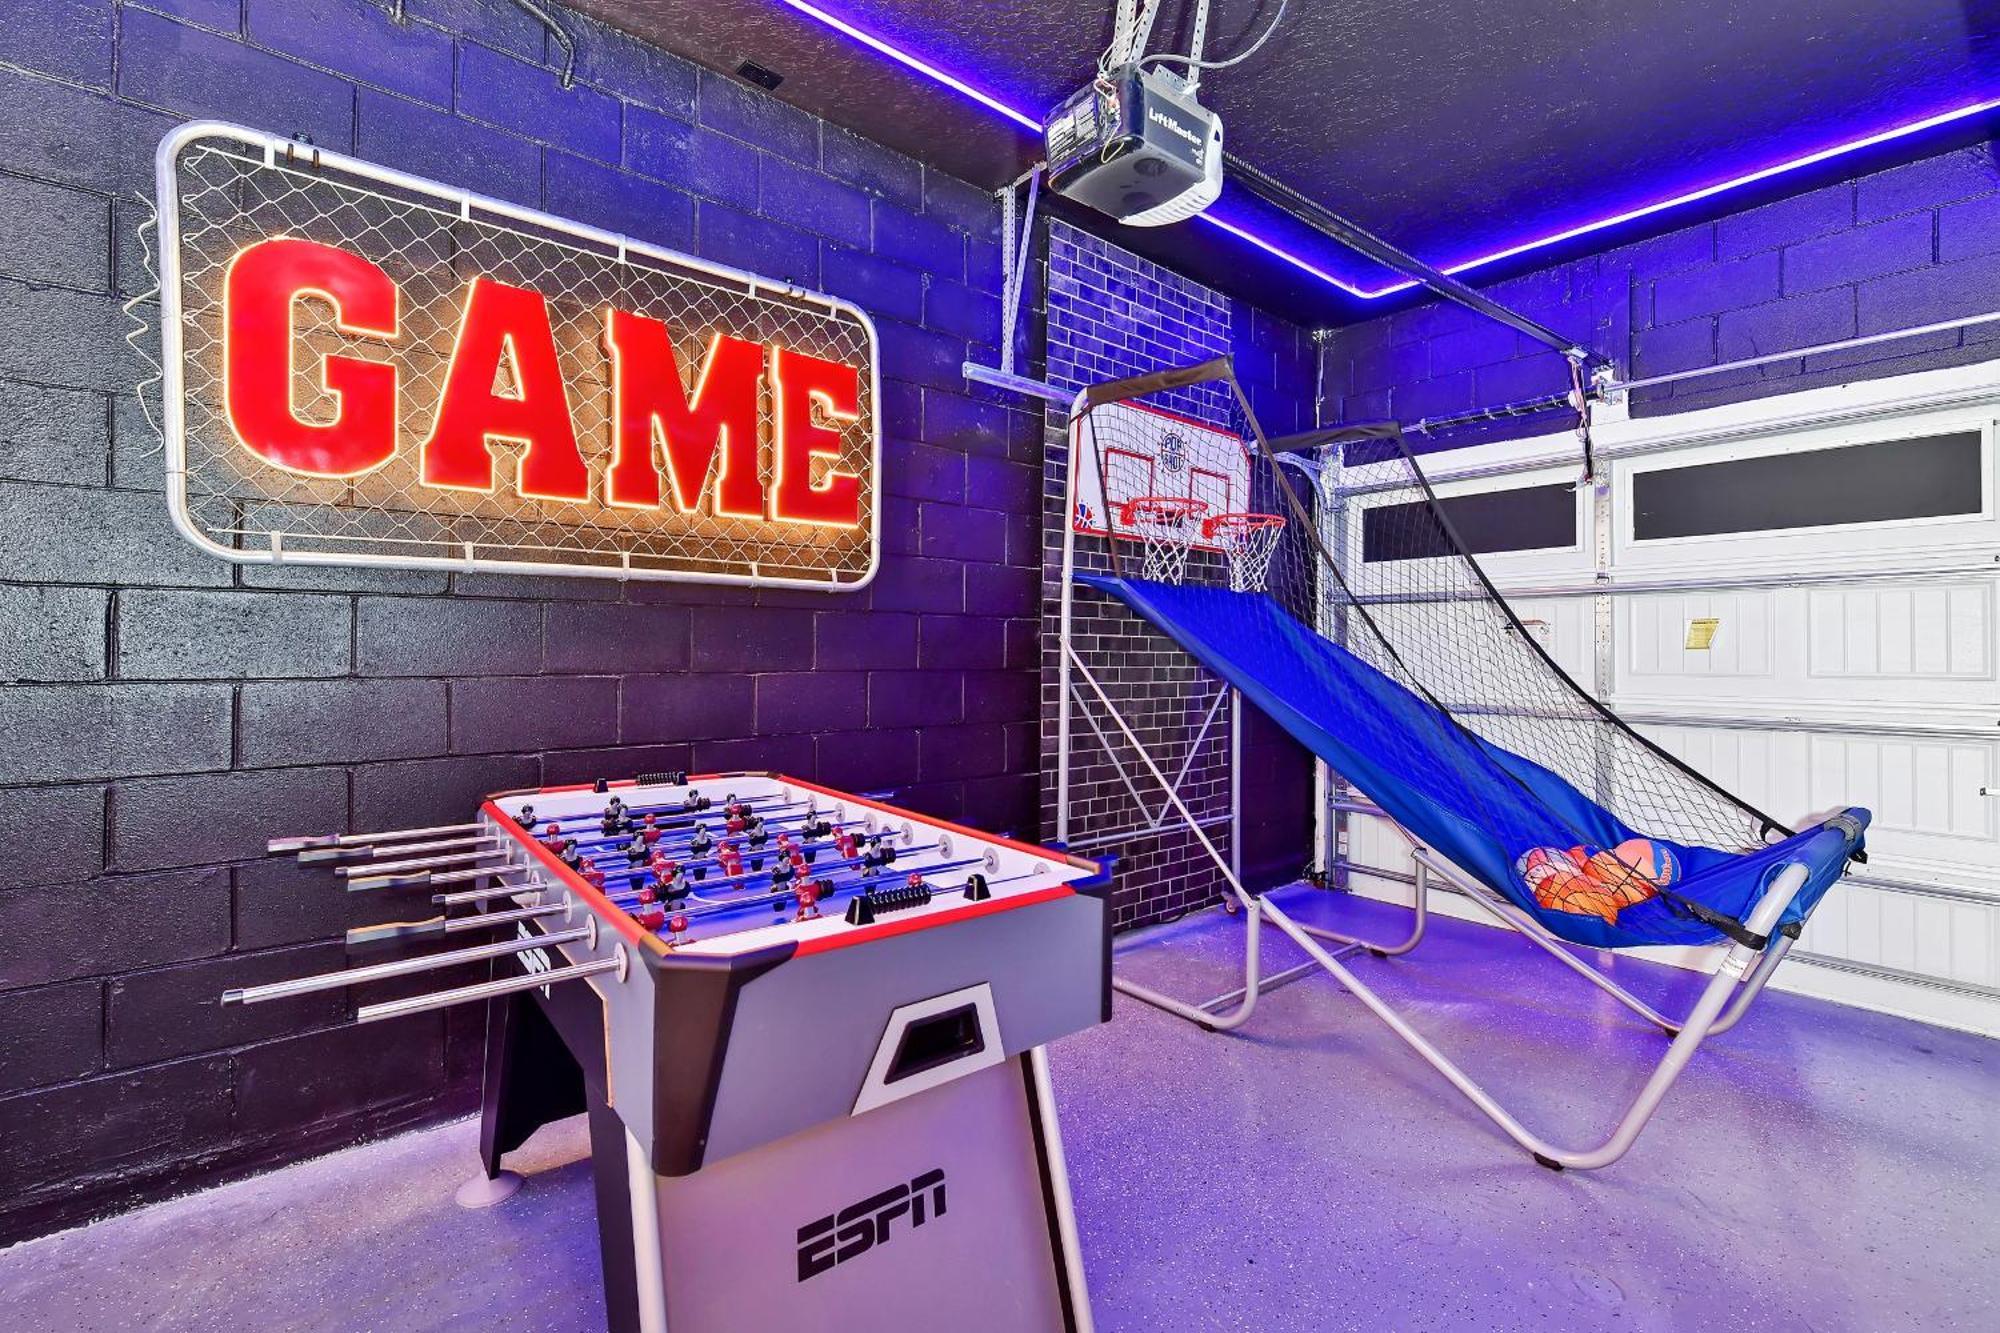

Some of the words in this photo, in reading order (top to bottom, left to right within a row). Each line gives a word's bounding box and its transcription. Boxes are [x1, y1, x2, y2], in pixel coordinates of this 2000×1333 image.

[1149, 106, 1202, 146] LiftMaster
[223, 235, 860, 526] GAME
[797, 1168, 946, 1283] ESPN
